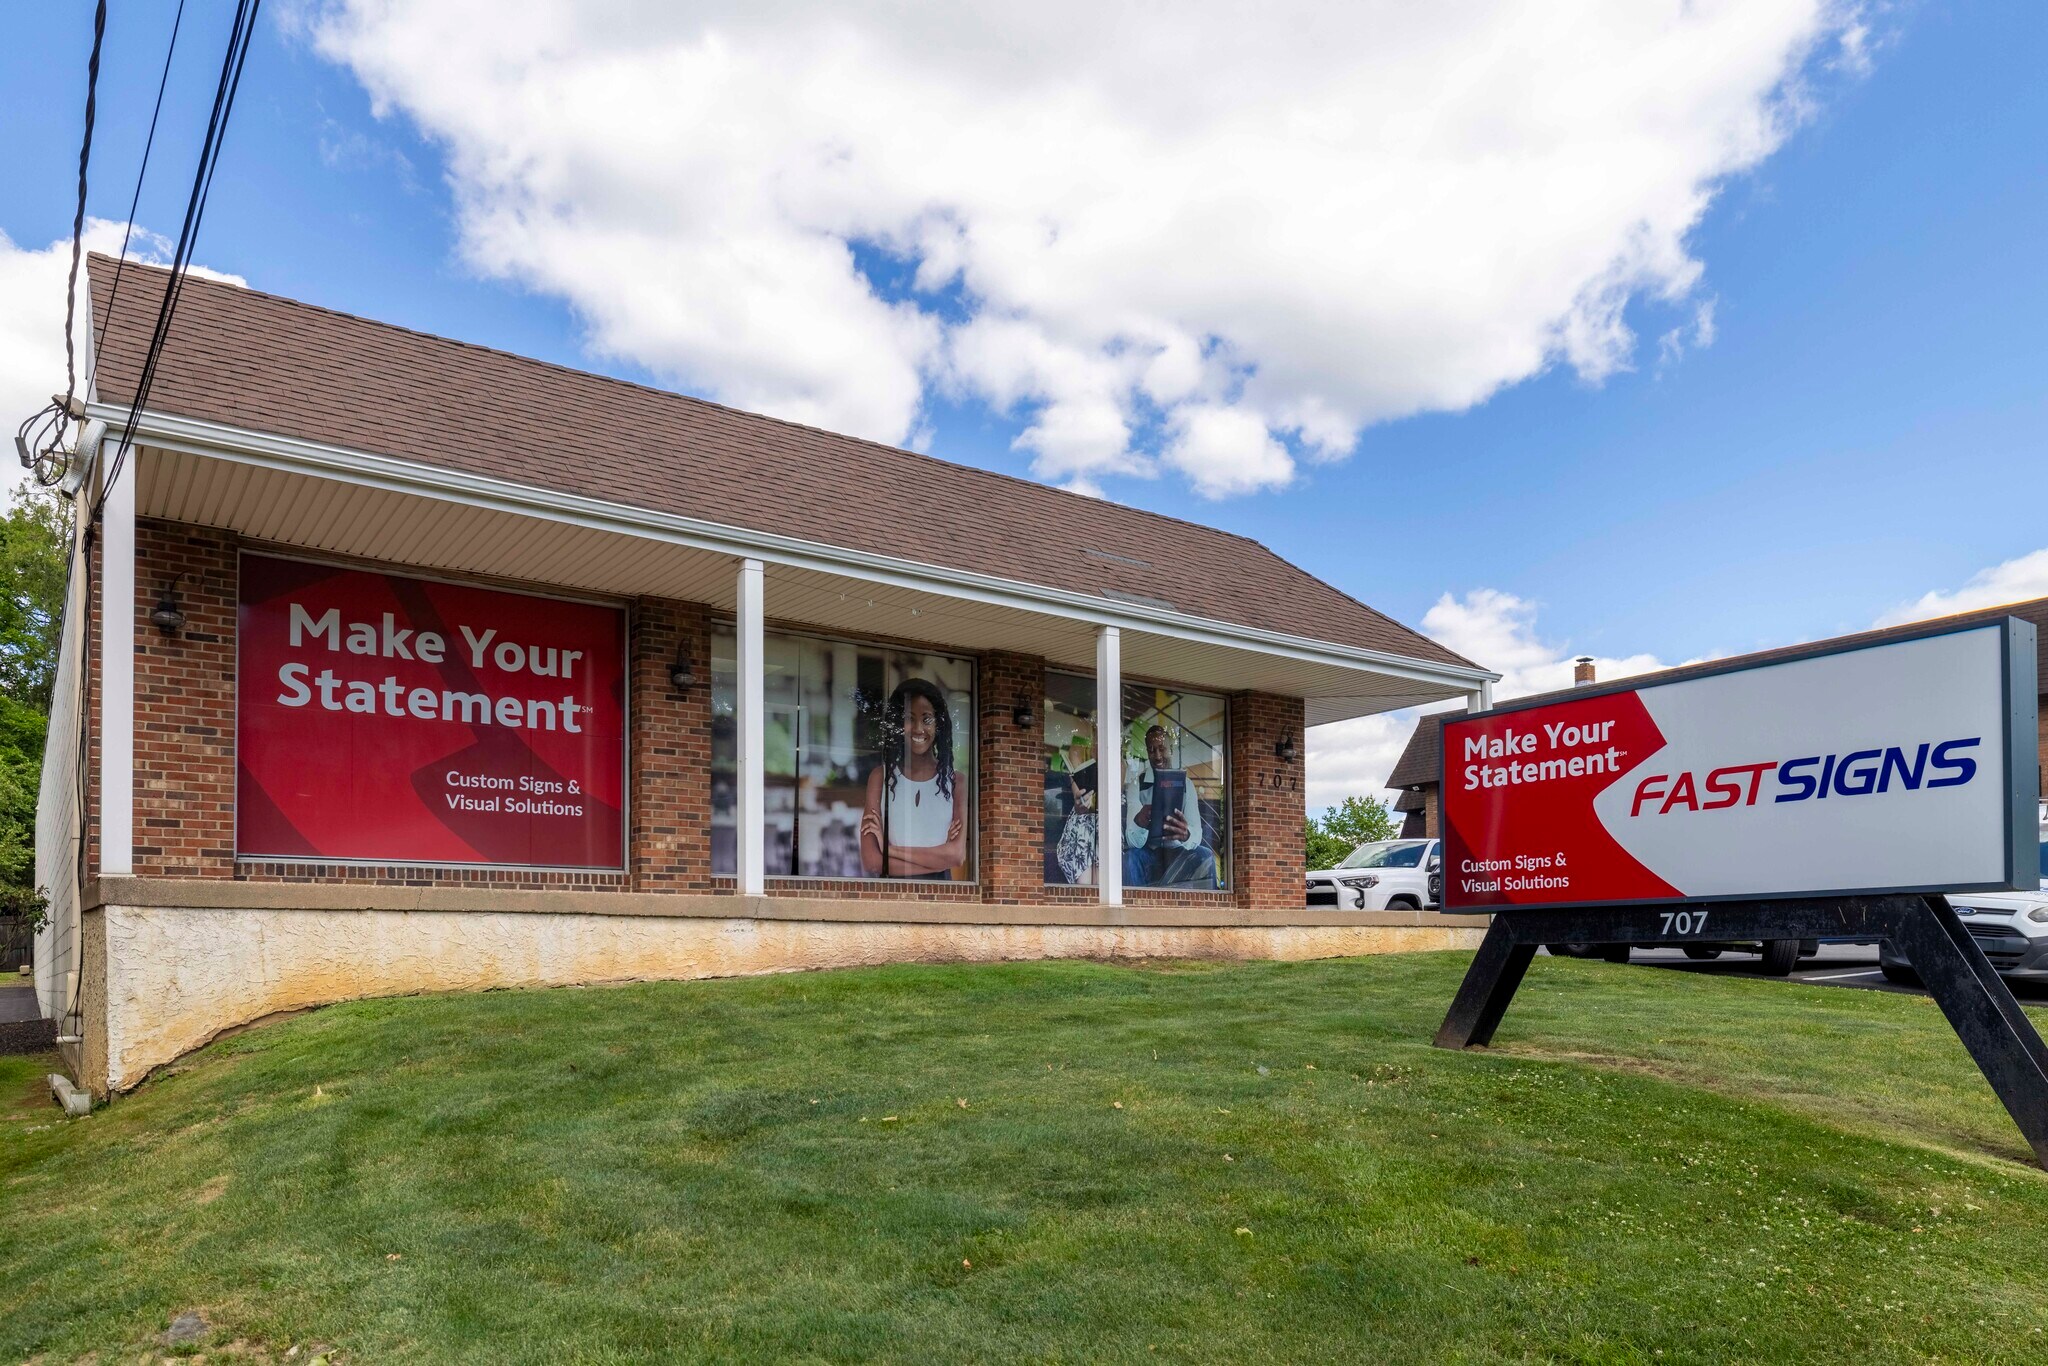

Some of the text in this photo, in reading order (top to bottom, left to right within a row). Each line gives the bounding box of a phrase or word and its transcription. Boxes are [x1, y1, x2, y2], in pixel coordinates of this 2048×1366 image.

[289, 602, 584, 680] Make Your
[276, 662, 582, 734] Statement
[1464, 719, 1616, 762] Make Your
[1257, 772, 1297, 791] 707
[1463, 746, 1621, 791] Statement
[1630, 736, 1982, 818] FASTSIGNS
[446, 770, 581, 796] Custom Signs &
[445, 793, 583, 817] Visual Solutions
[1461, 851, 1567, 873] Custom Signs &
[1461, 874, 1570, 893] Visual Solutions
[1659, 910, 1709, 935] 707
